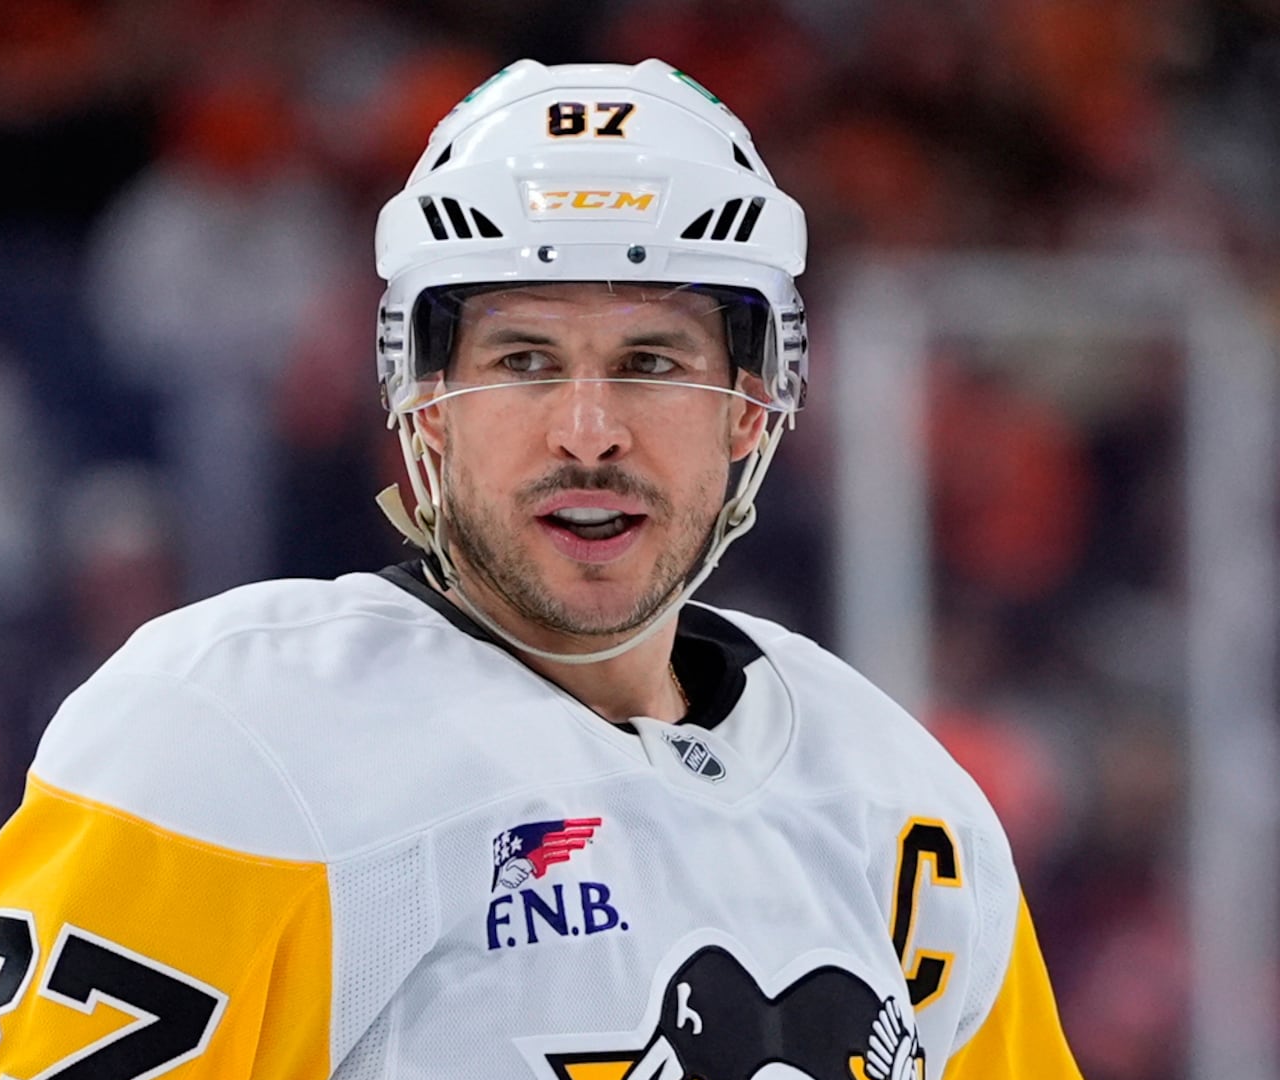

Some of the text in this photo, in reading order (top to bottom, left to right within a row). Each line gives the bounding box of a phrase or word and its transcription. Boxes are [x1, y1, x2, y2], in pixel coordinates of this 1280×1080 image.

[547, 101, 638, 139] 87
[529, 190, 656, 211] CCM
[684, 743, 708, 773] NHL
[487, 881, 629, 951] F.N.B.
[890, 815, 963, 1013] C
